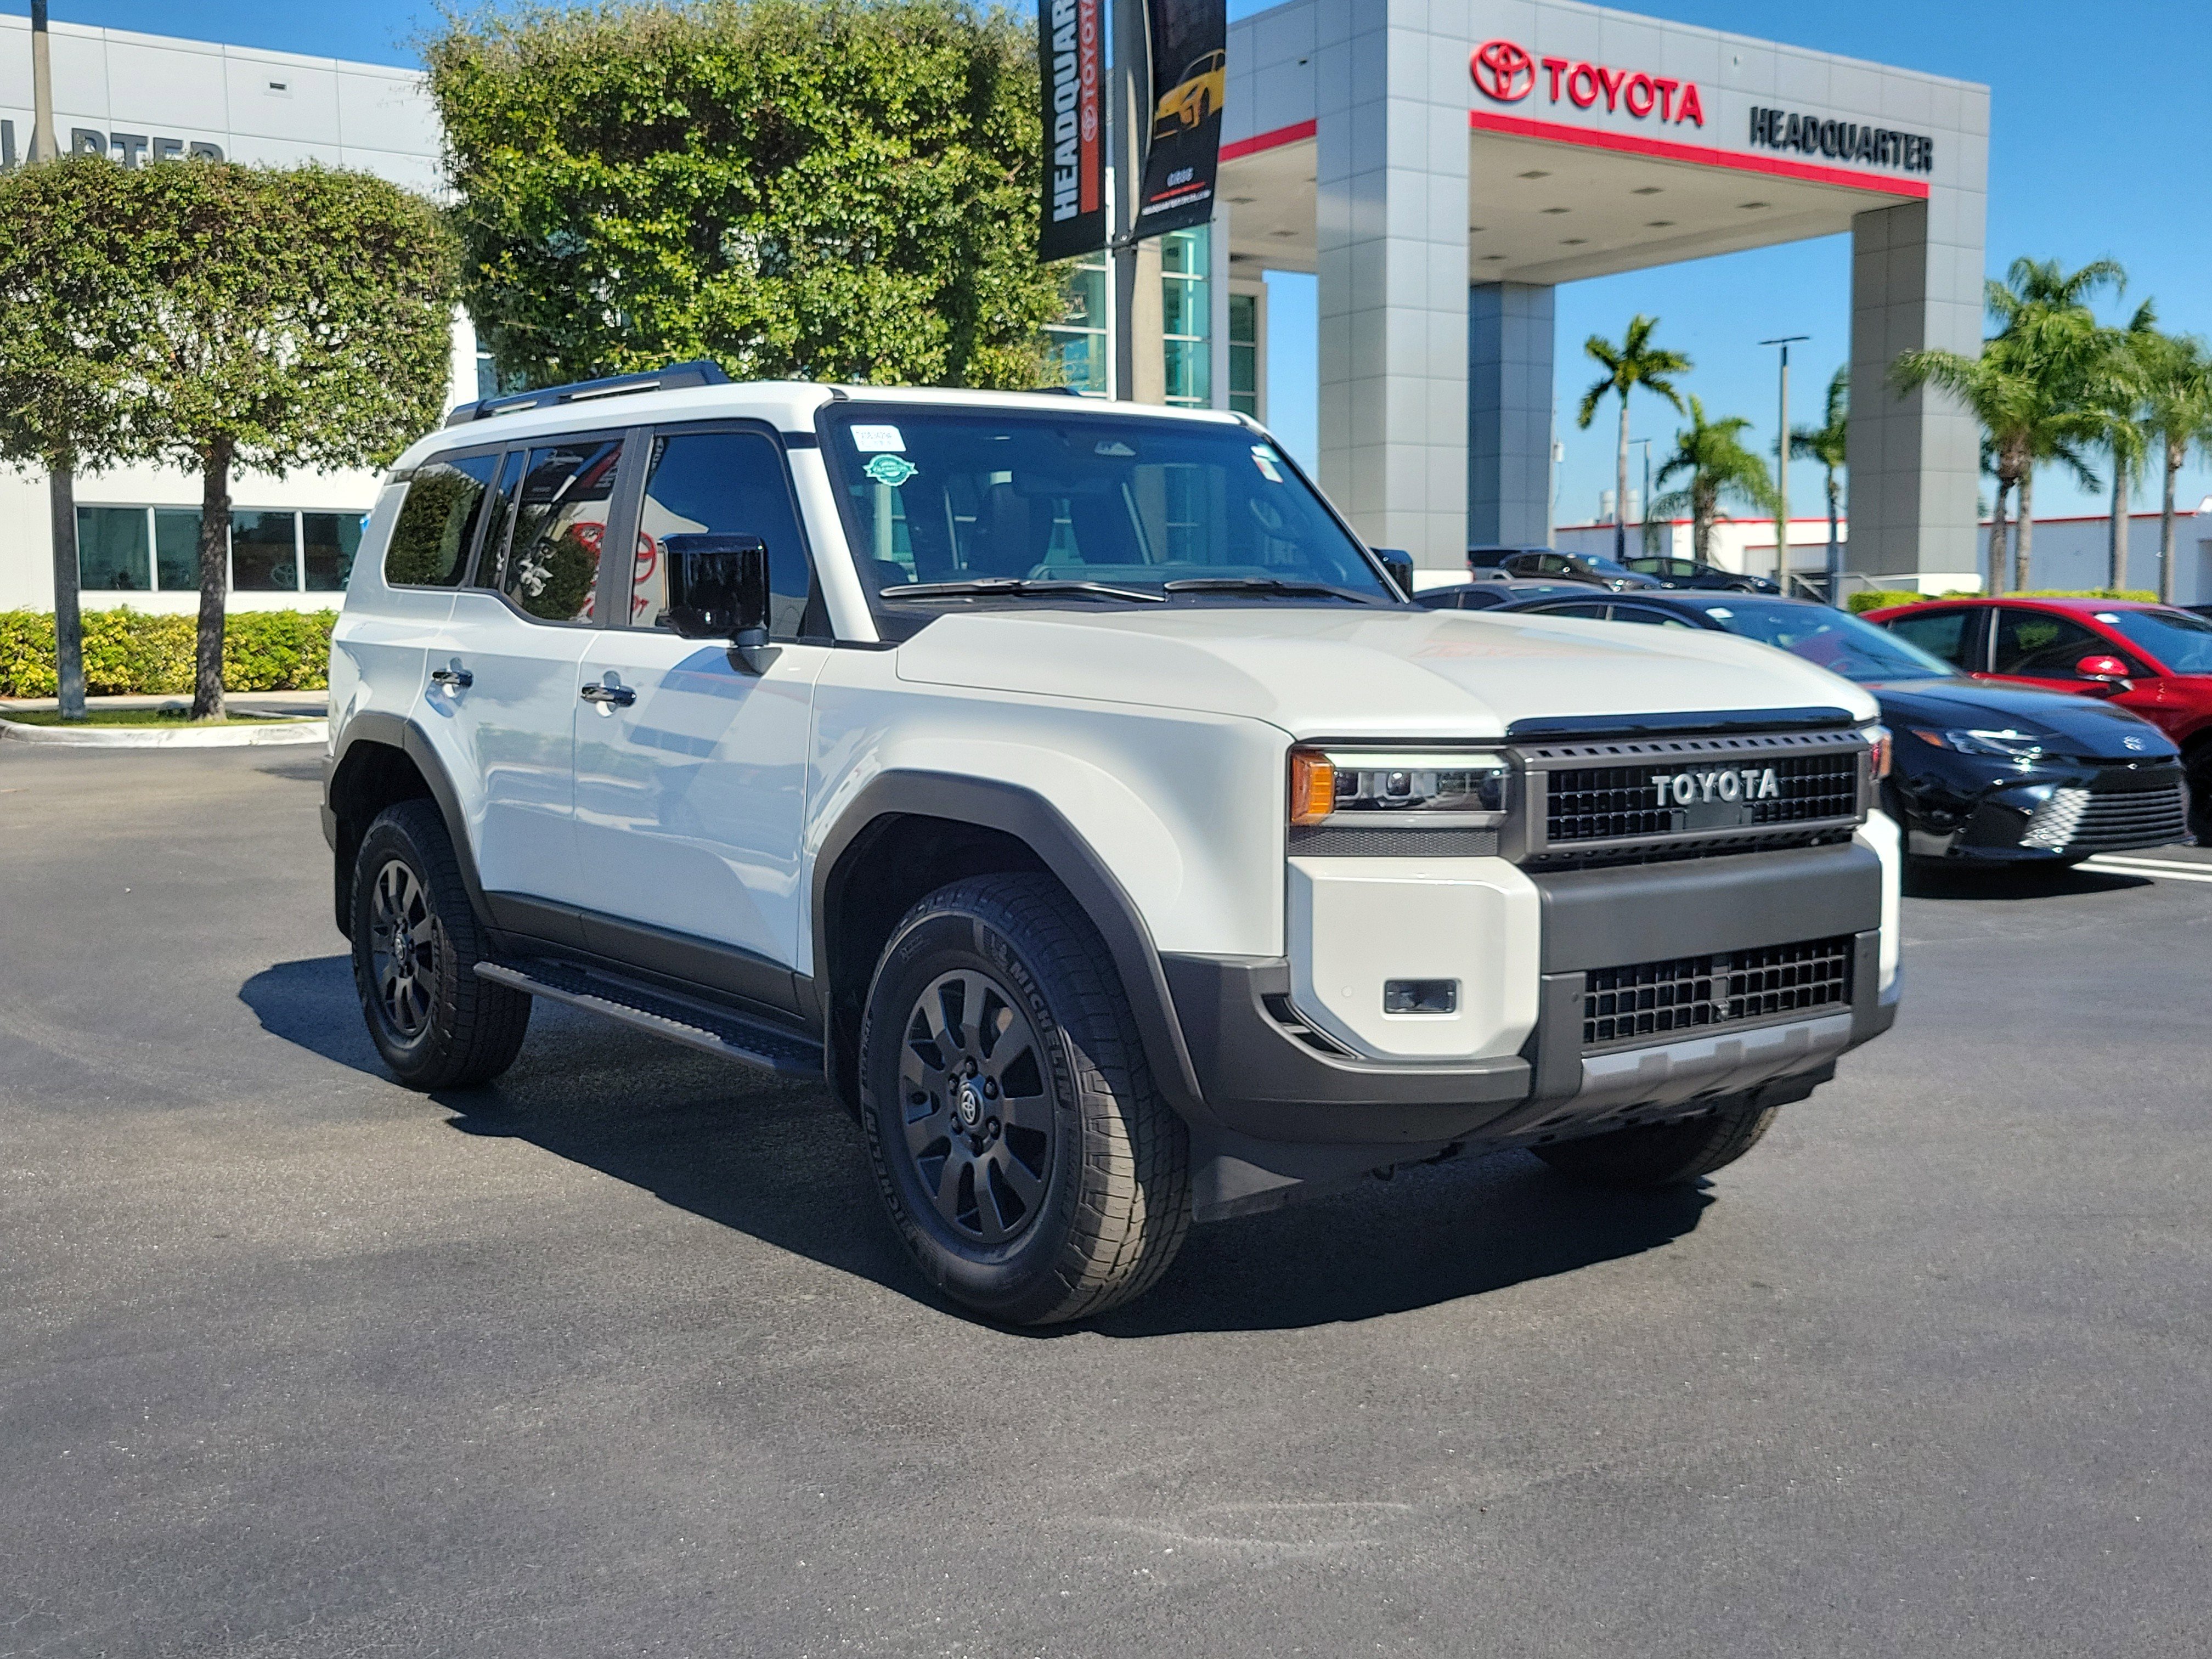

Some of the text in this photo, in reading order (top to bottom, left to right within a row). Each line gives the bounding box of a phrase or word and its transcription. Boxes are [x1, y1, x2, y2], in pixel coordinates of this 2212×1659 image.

[1082, 0, 1096, 104] TOYOT
[1542, 57, 1933, 173] TOYOTA HEADQUARTER
[1651, 768, 1780, 806] TOYOTA
[1009, 961, 1076, 1104] MICHELIN
